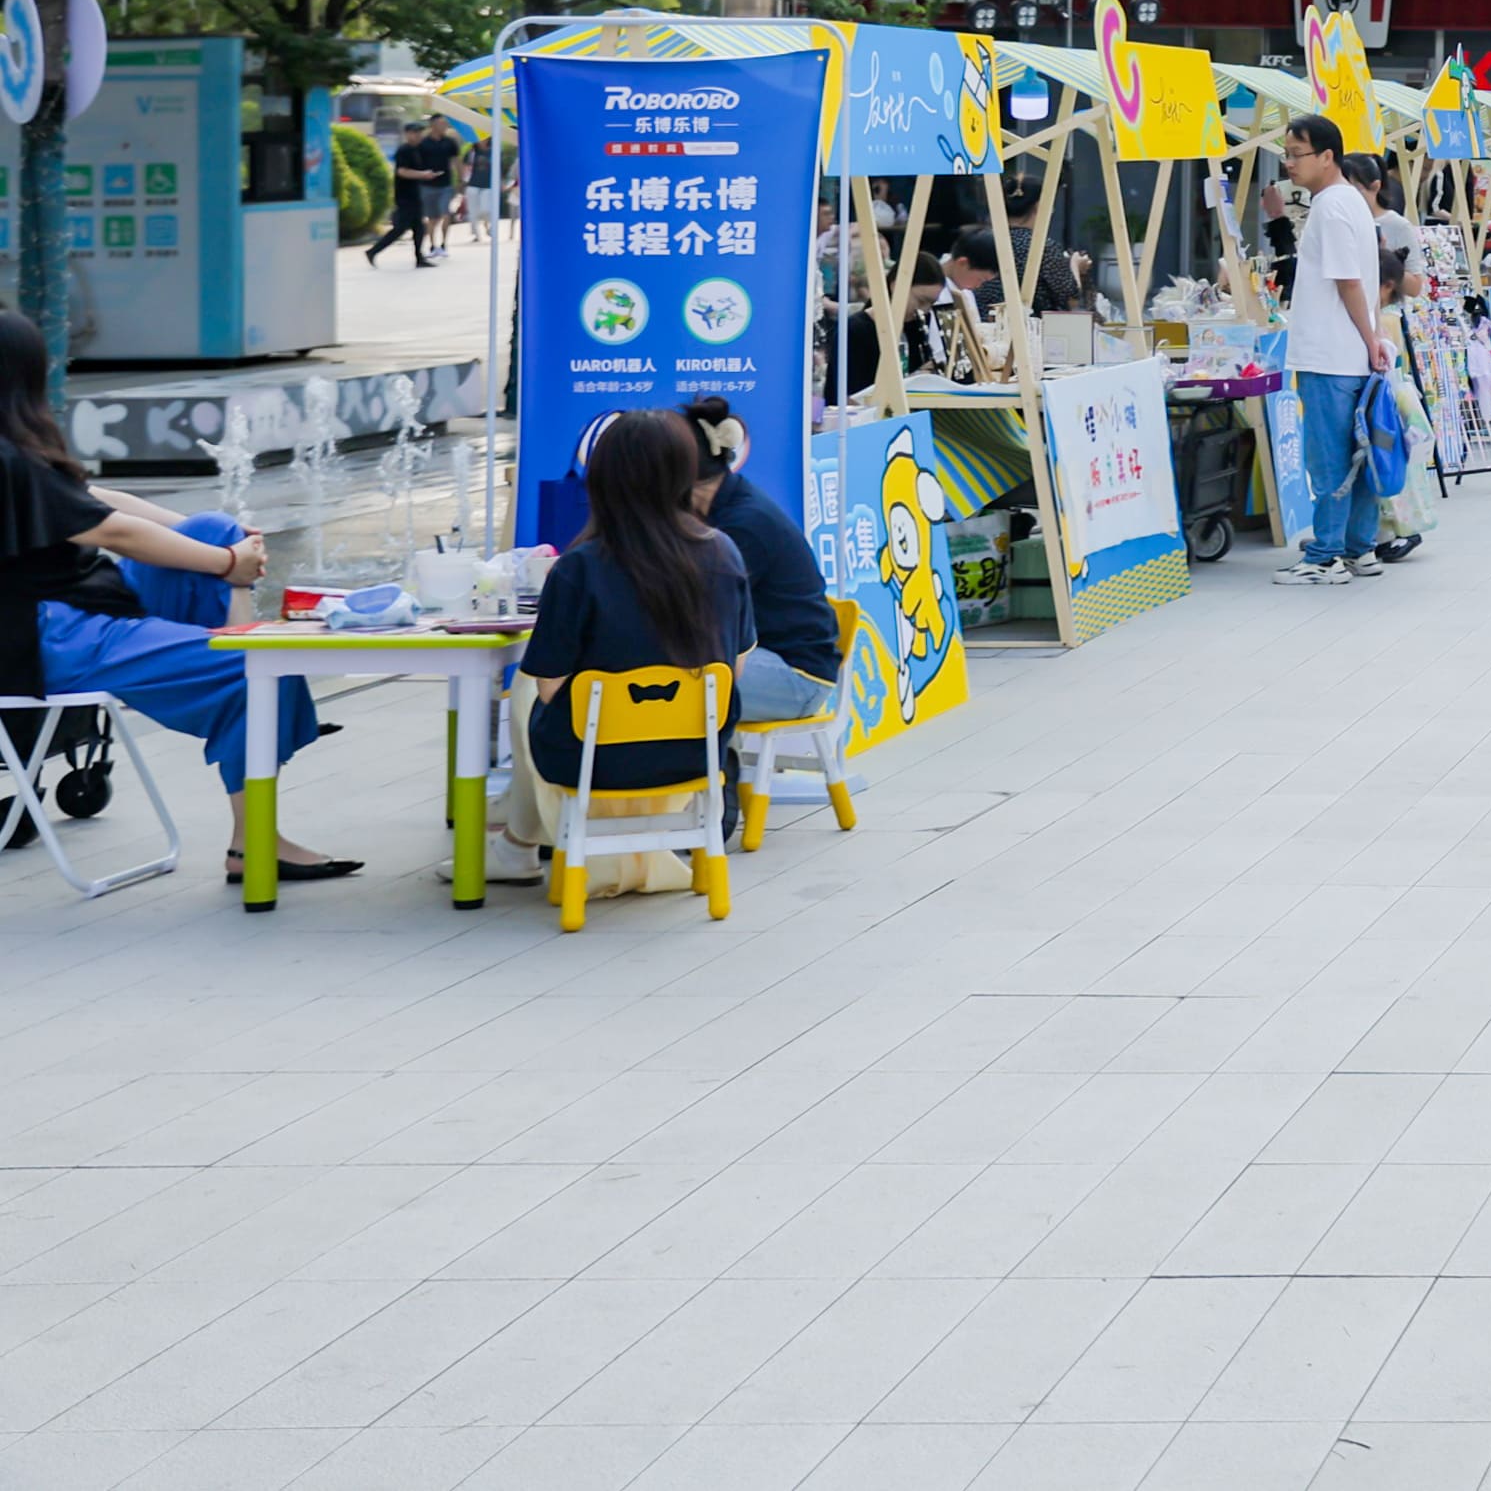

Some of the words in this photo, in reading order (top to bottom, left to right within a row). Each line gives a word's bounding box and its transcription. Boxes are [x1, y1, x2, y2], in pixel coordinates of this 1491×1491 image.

[1260, 55, 1293, 67] KFC
[604, 86, 741, 110] ROBOROBO
[635, 117, 710, 134] 乐博乐博
[585, 176, 758, 212] 乐博乐博
[583, 220, 758, 257] 课程介绍
[570, 357, 657, 373] UARO机器人
[676, 357, 757, 372] KIRO机器人
